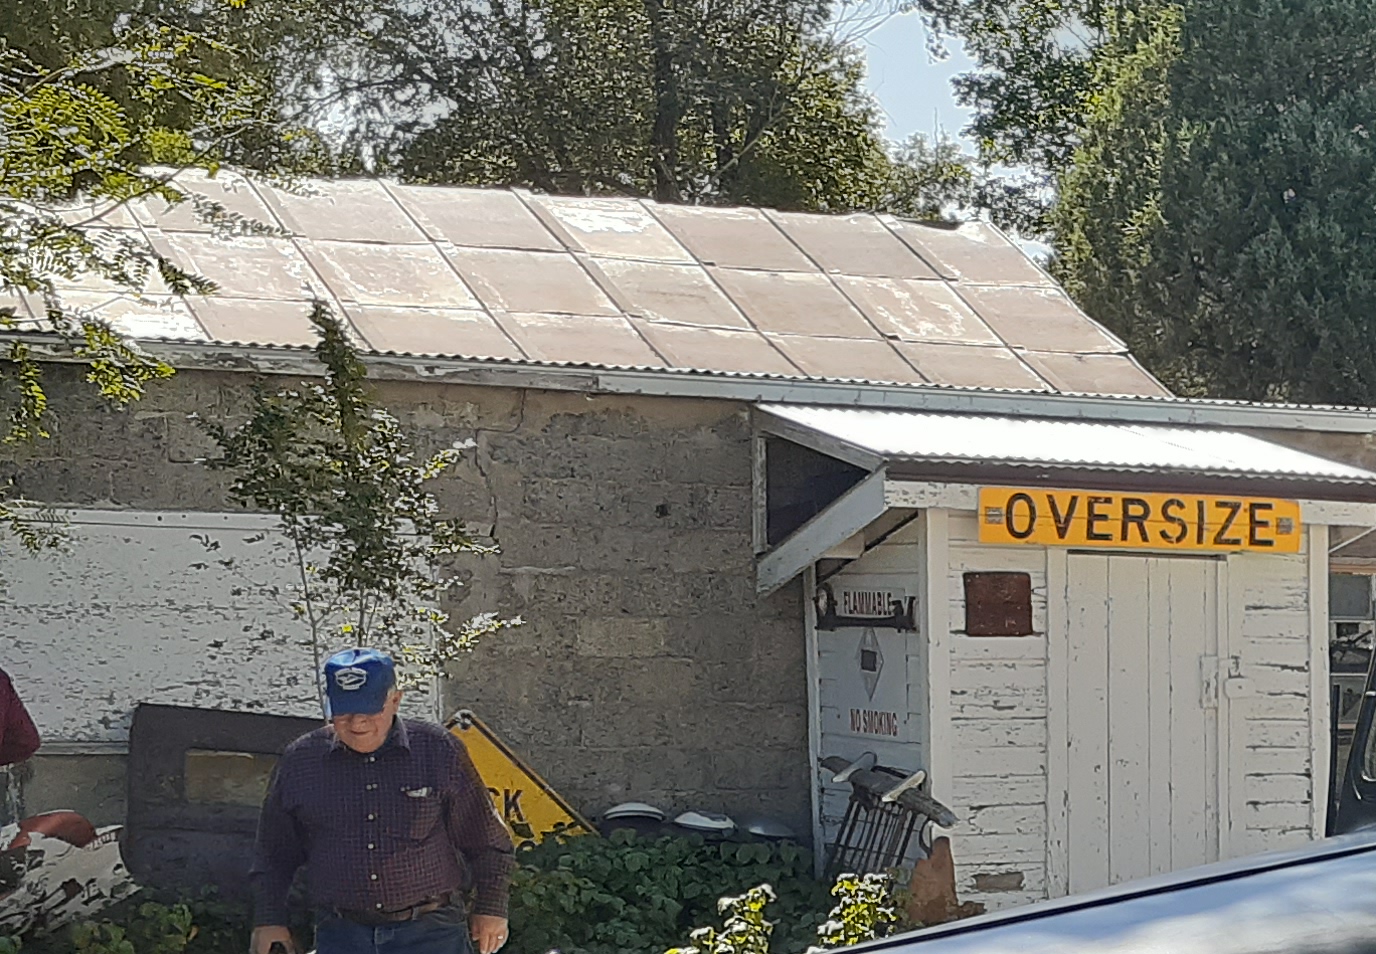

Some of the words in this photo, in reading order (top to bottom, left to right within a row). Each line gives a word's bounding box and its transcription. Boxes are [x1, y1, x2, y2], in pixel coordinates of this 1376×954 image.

[1005, 492, 1275, 547] OVERSIZE
[843, 591, 892, 616] FLAMMABLE
[850, 708, 862, 732] NO
[863, 709, 898, 737] SMOKING
